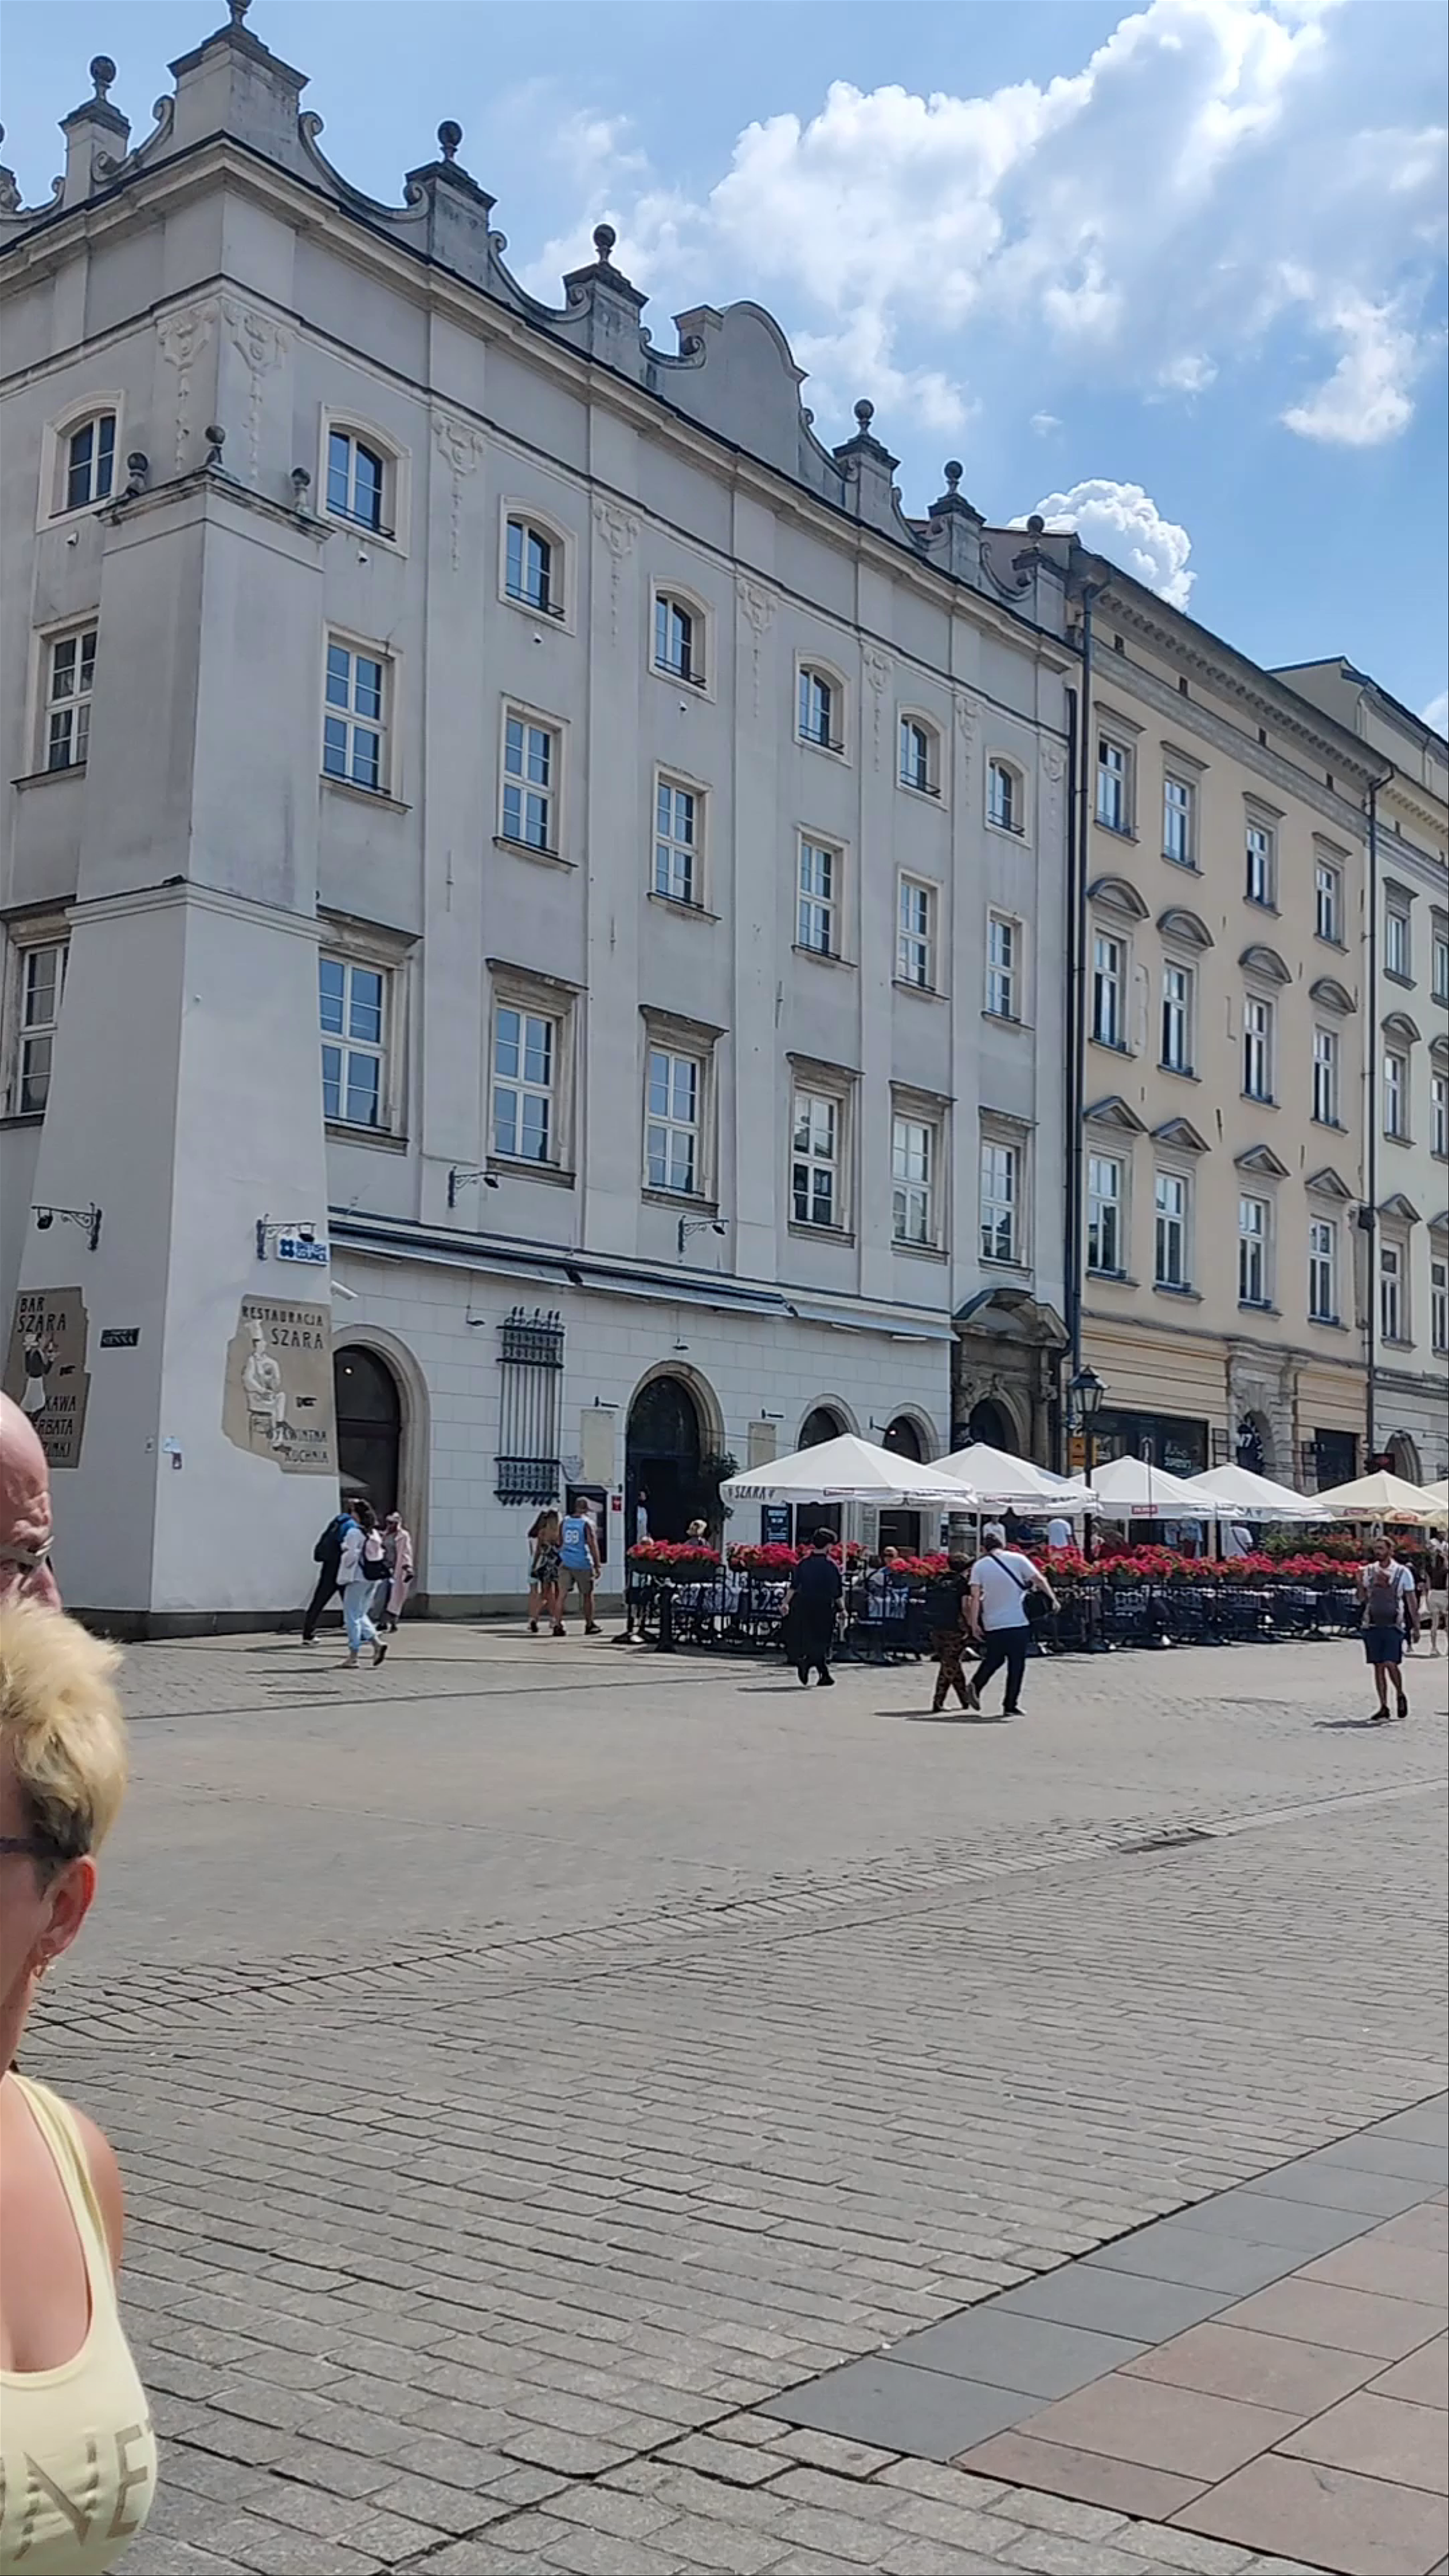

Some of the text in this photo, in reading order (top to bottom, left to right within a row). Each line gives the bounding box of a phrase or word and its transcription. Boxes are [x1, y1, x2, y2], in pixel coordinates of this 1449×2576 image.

[20, 1296, 45, 1313] BAR
[17, 1313, 66, 1333] SZARA
[242, 1306, 323, 1327] RESTAURACJA
[271, 1328, 324, 1349] SZARA
[45, 1395, 76, 1412] KAWA
[33, 1418, 73, 1435] ERBATA
[734, 1486, 766, 1500] SZARA
